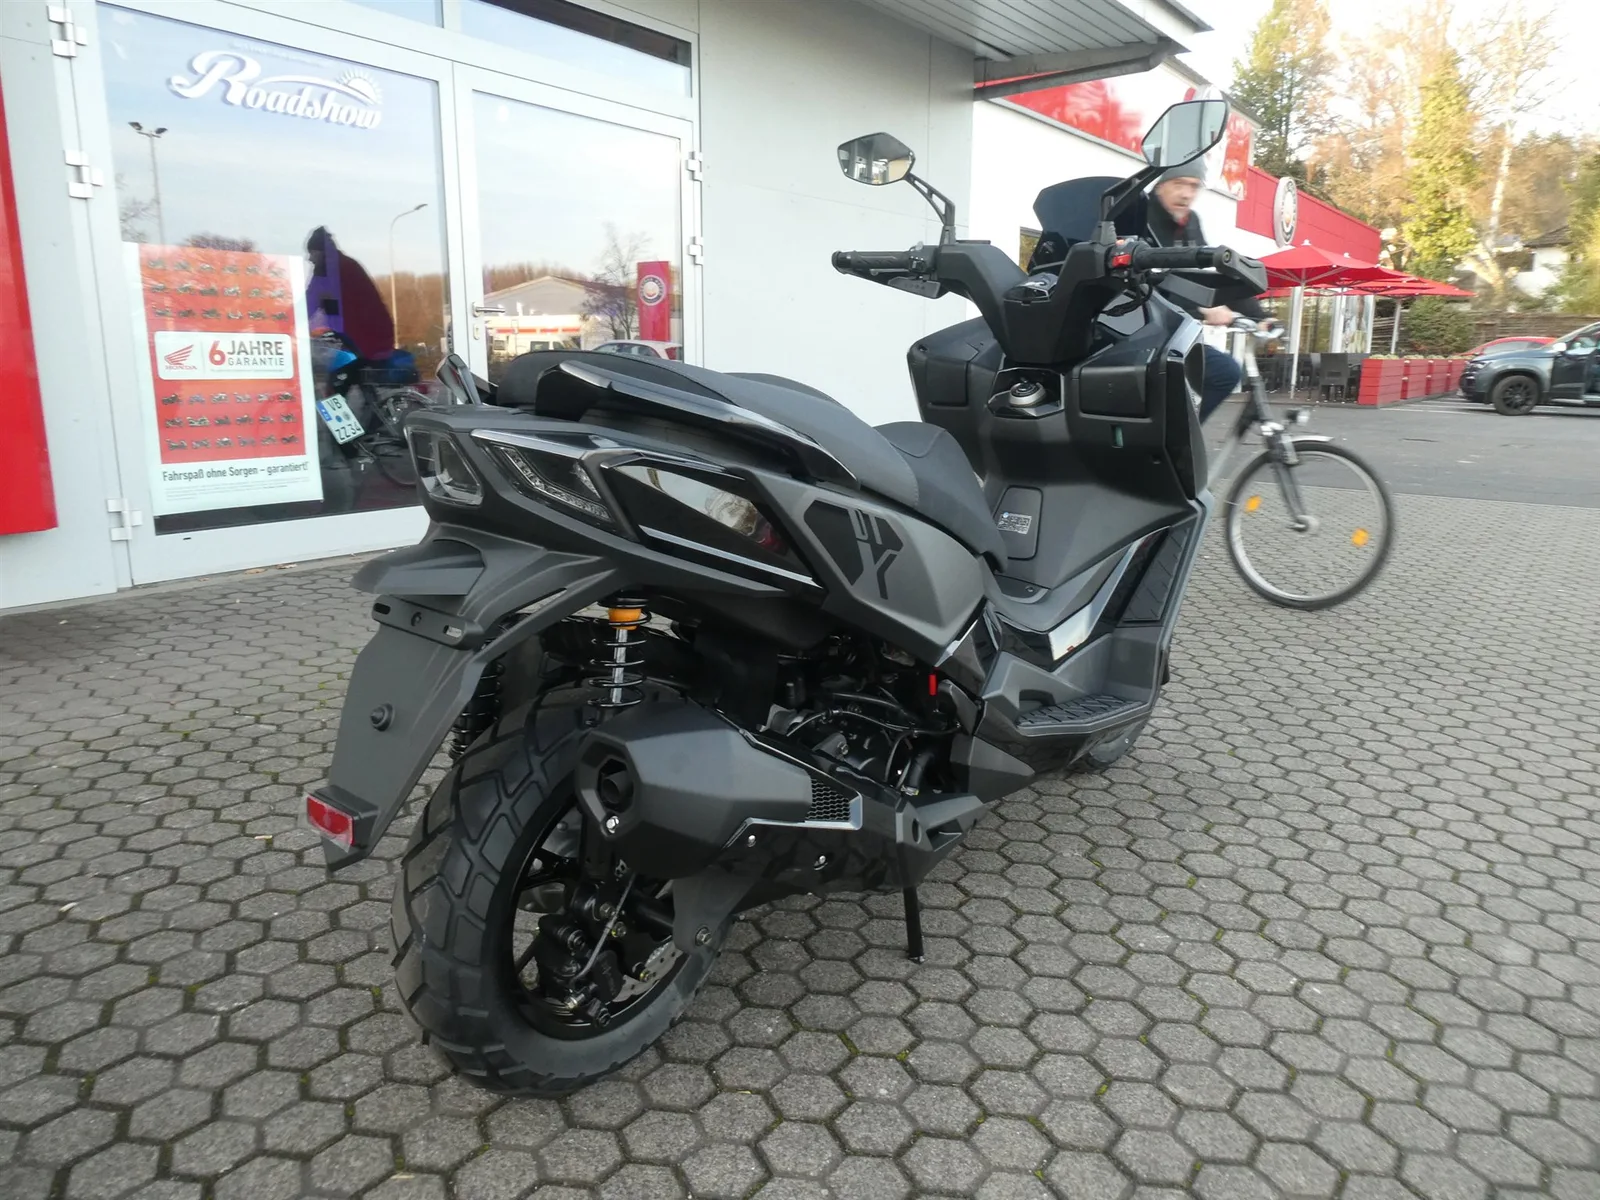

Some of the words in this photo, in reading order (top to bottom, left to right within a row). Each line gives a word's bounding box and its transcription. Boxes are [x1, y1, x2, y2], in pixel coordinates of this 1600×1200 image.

[167, 50, 382, 130] Roadshow
[208, 340, 226, 366] 6
[227, 340, 284, 356] JAHRE
[227, 357, 285, 367] GARANTIE
[162, 468, 205, 482] Fahrspaß
[206, 470, 227, 479] ohne
[229, 465, 258, 478] Sorgen
